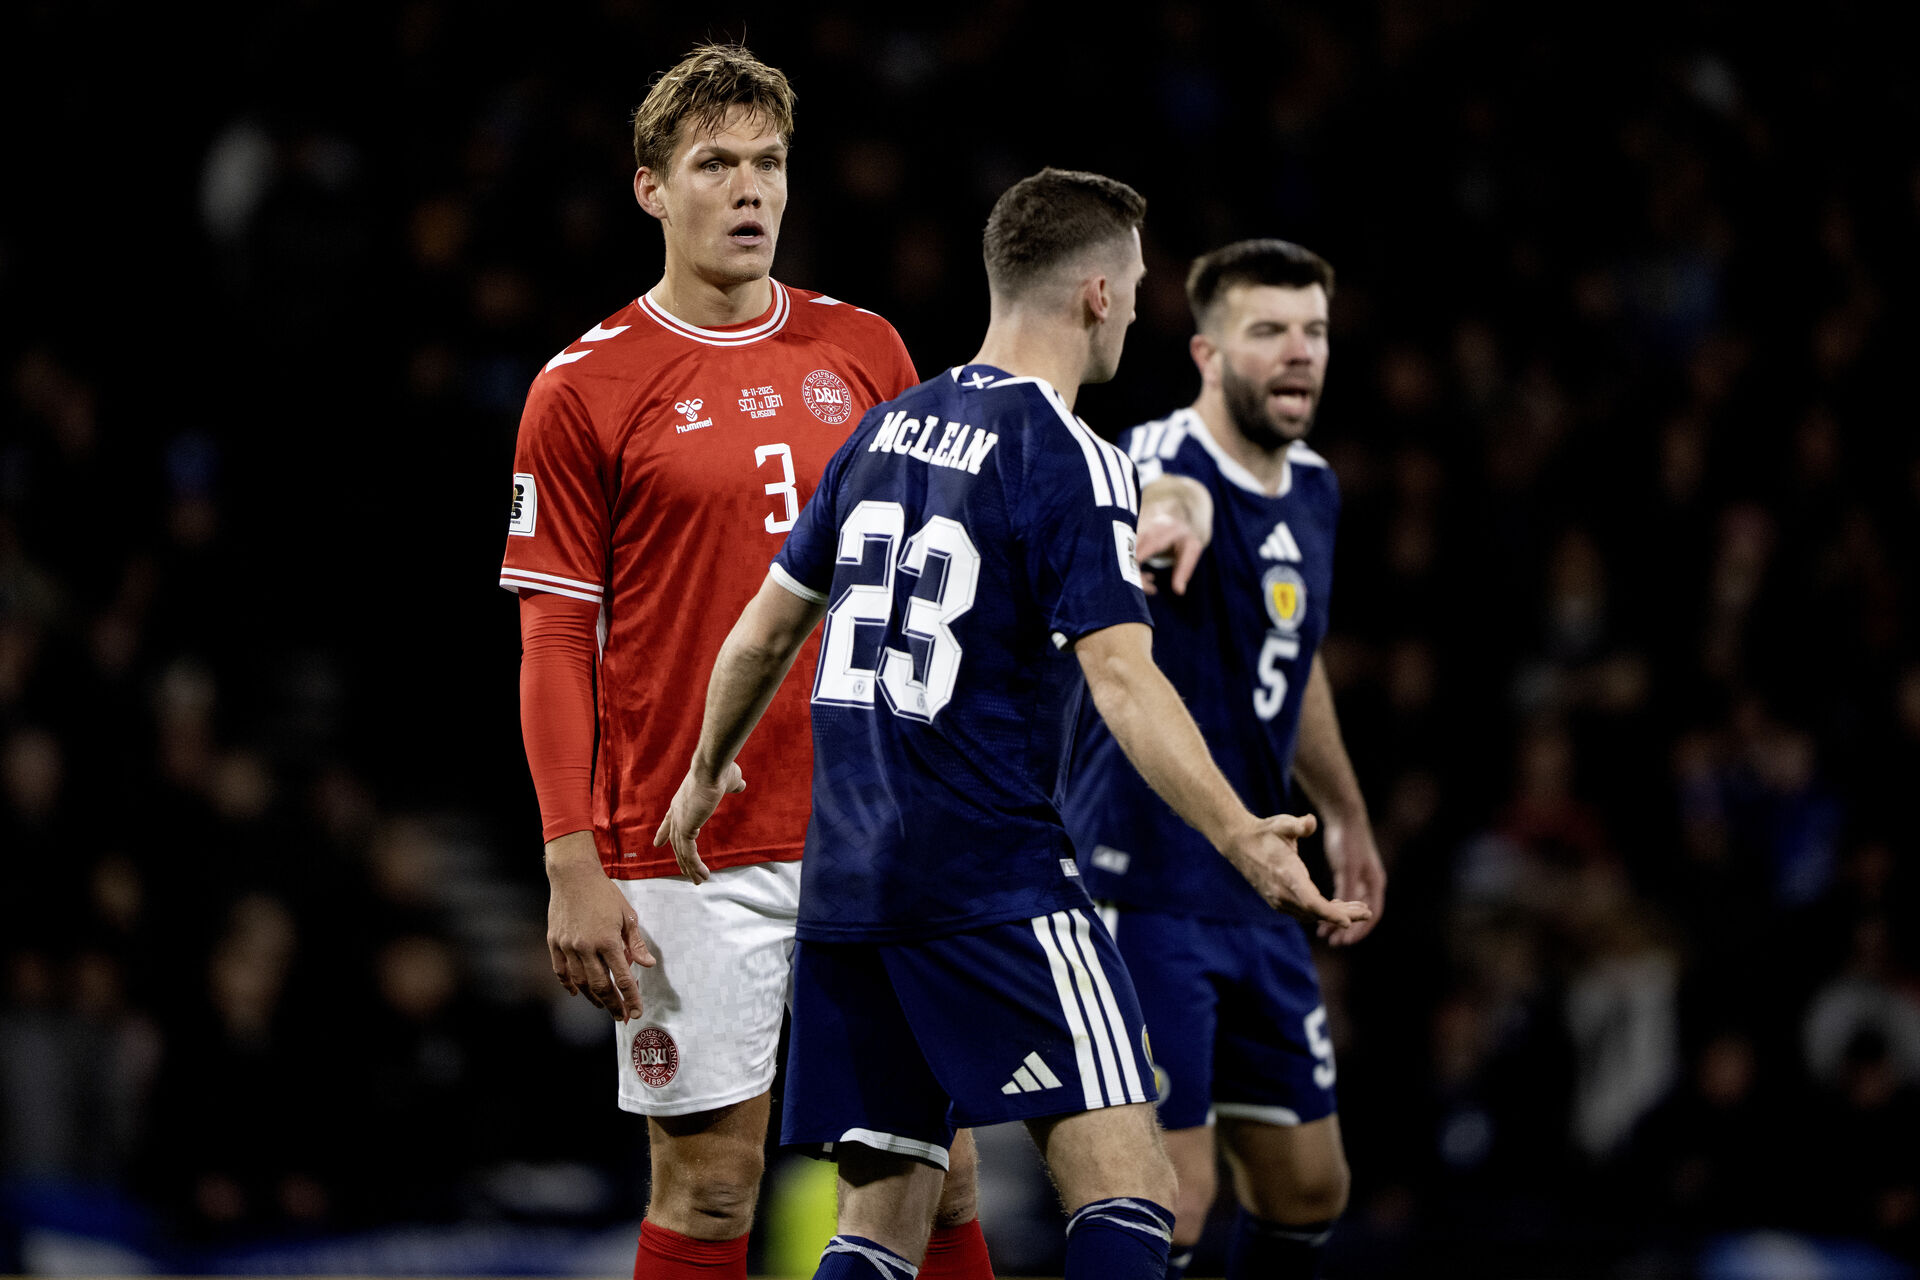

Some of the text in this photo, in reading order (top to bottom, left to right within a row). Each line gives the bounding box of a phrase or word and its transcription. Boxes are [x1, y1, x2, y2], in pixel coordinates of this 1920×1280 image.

[738, 397, 757, 412] SCO
[804, 384, 822, 416] DANSK
[812, 387, 844, 404] DBU
[750, 409, 777, 419] GLASGOW
[823, 414, 843, 422] 1889
[675, 416, 713, 434] hummel
[754, 442, 800, 535] 3
[810, 500, 982, 724] 23
[1252, 634, 1301, 722] 5
[1302, 1004, 1338, 1090] 5
[639, 1047, 669, 1066] DBU
[647, 1076, 667, 1085] 1889
